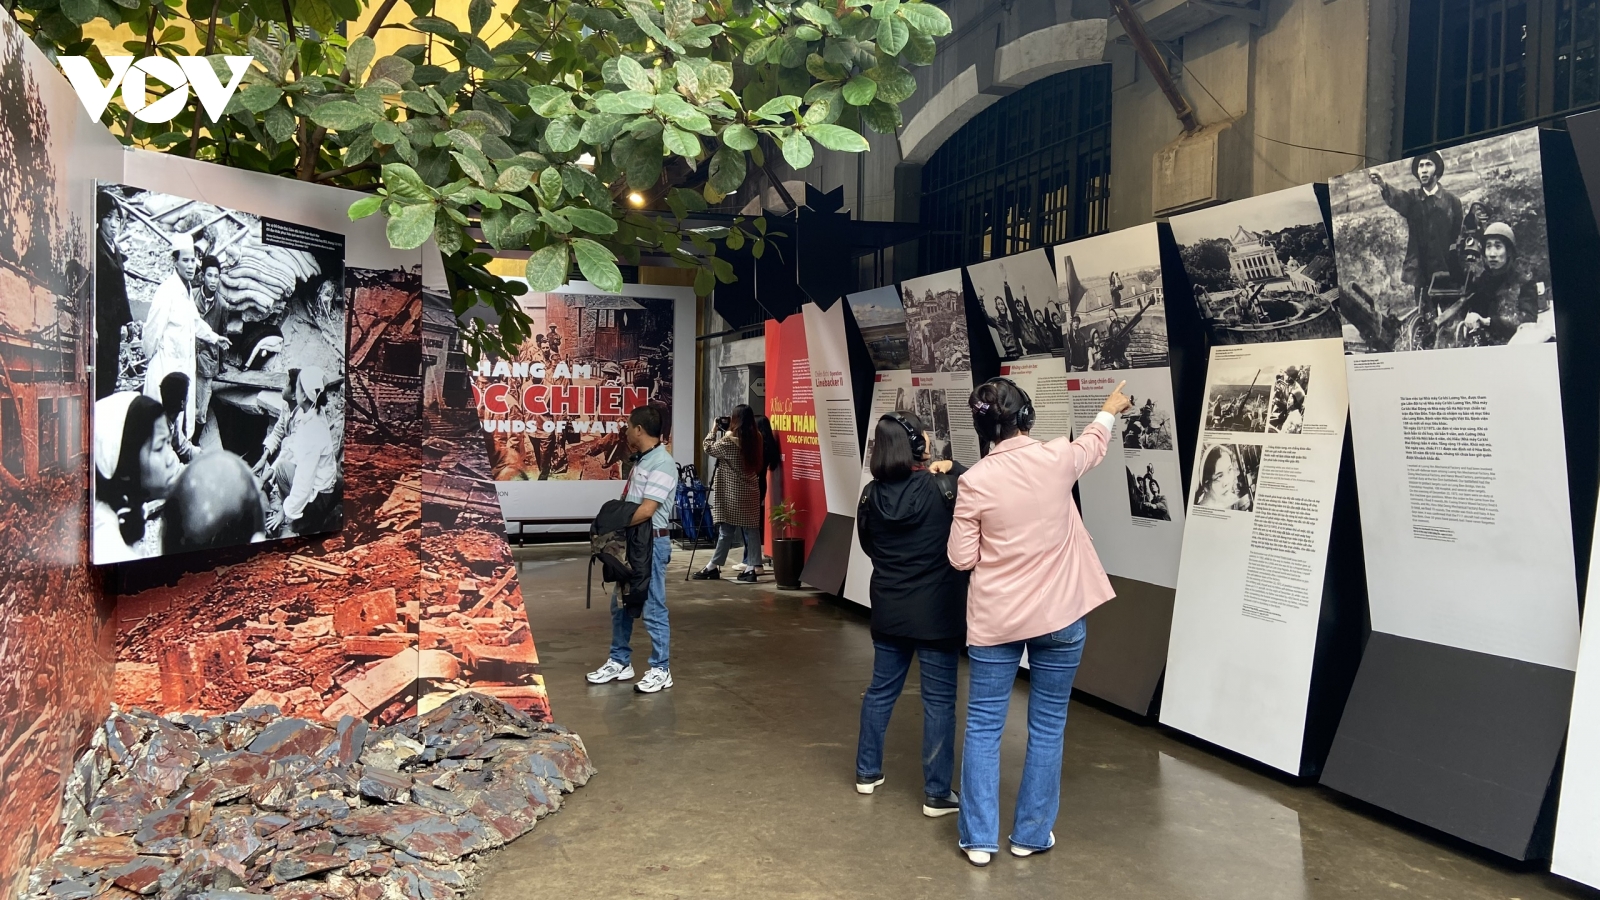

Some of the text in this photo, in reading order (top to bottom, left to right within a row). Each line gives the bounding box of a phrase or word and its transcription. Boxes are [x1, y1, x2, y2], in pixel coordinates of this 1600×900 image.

[472, 361, 545, 378] HANG
[816, 378, 839, 387] Linebacker
[480, 420, 537, 433] UNDS
[542, 420, 567, 433] OF
[787, 435, 820, 445] SONG OF VICTOR
